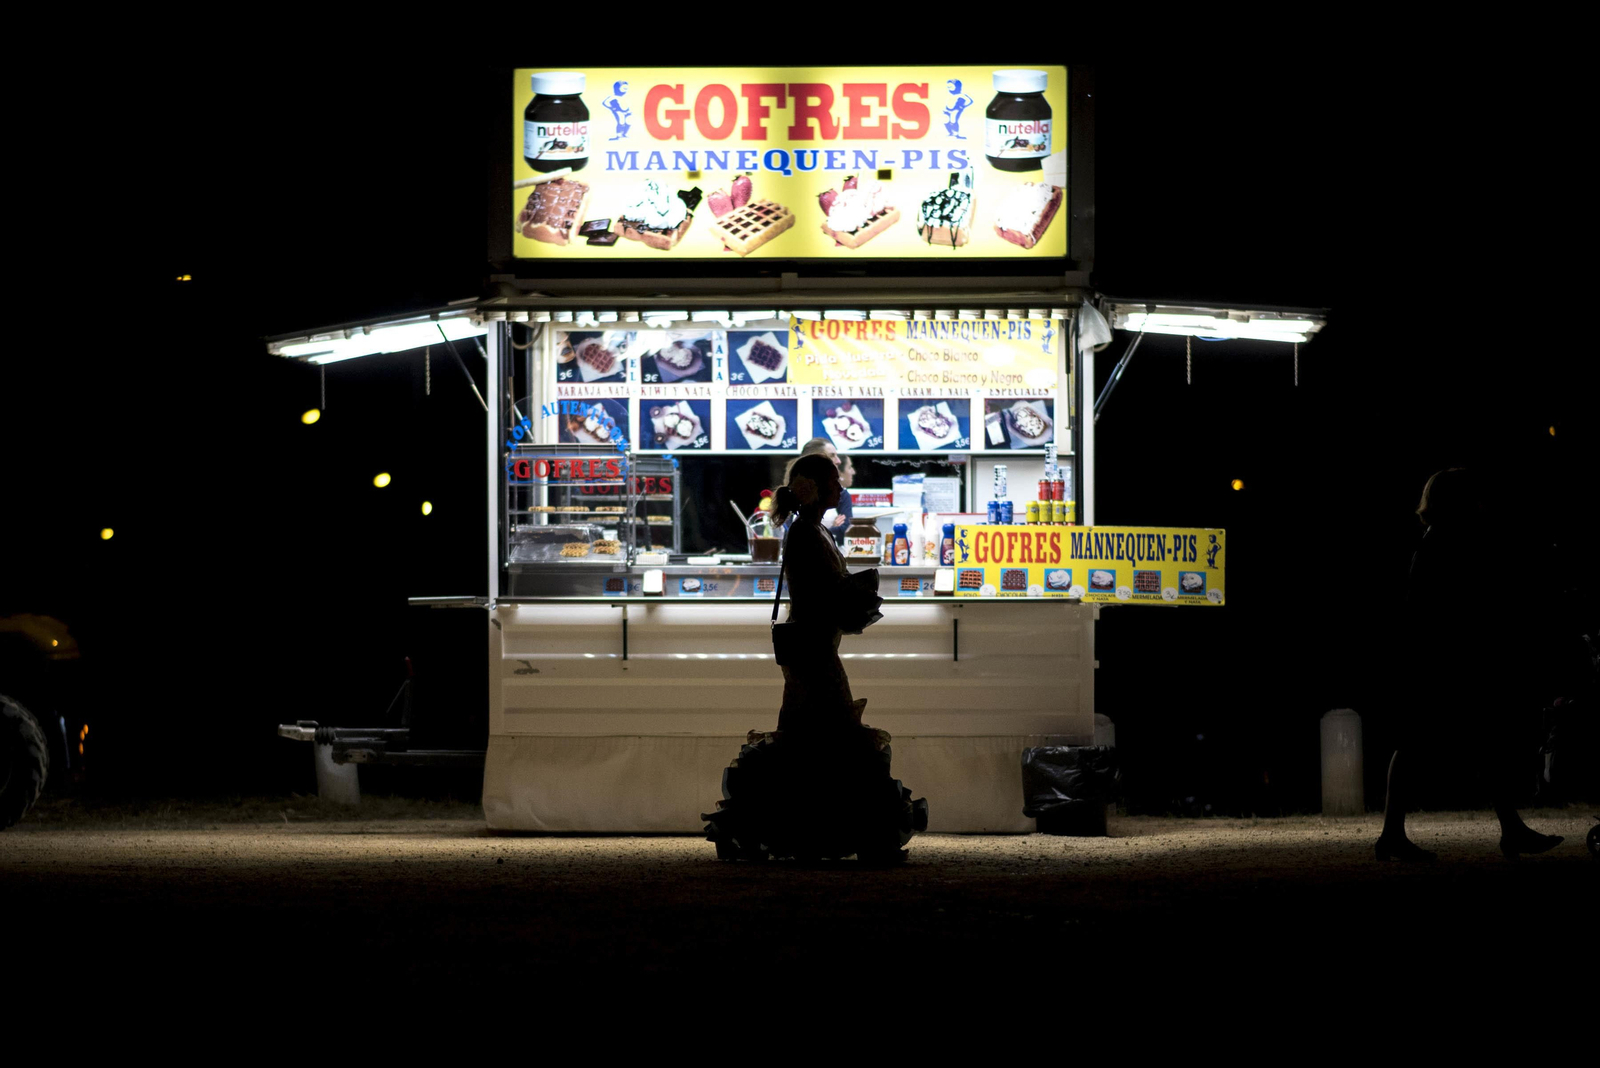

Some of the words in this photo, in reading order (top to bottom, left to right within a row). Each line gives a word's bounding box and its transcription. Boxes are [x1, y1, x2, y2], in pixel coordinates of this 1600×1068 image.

[643, 82, 931, 142] GOFRES
[537, 121, 587, 137] nutella
[998, 120, 1050, 135] nutella
[605, 149, 970, 176] MANNEQUEN-PIS
[810, 320, 897, 341] GOFRES
[906, 320, 1032, 343] MANNEQUEN-PIS
[908, 348, 940, 362] Choco
[943, 348, 979, 362] Blanco
[643, 373, 659, 383] 3€
[730, 372, 745, 381] 3€
[907, 370, 939, 383] Choco
[942, 370, 978, 383] Blanco
[981, 375, 987, 386] y
[990, 371, 1023, 386] Negro
[557, 386, 601, 397] NARANJA
[640, 386, 667, 397] KIWI
[685, 386, 712, 397] NATA
[725, 386, 759, 397] CHOCO
[774, 386, 798, 397] NATA
[811, 386, 843, 397] FRESA
[859, 386, 884, 397] NATA
[989, 387, 1050, 397] ESPECIALES
[506, 415, 532, 452] LOS
[513, 459, 621, 479] GOFRES
[848, 537, 876, 546] nutella
[974, 531, 1062, 565] GOFRES
[1070, 531, 1198, 568] MANNEQUEN-PIS
